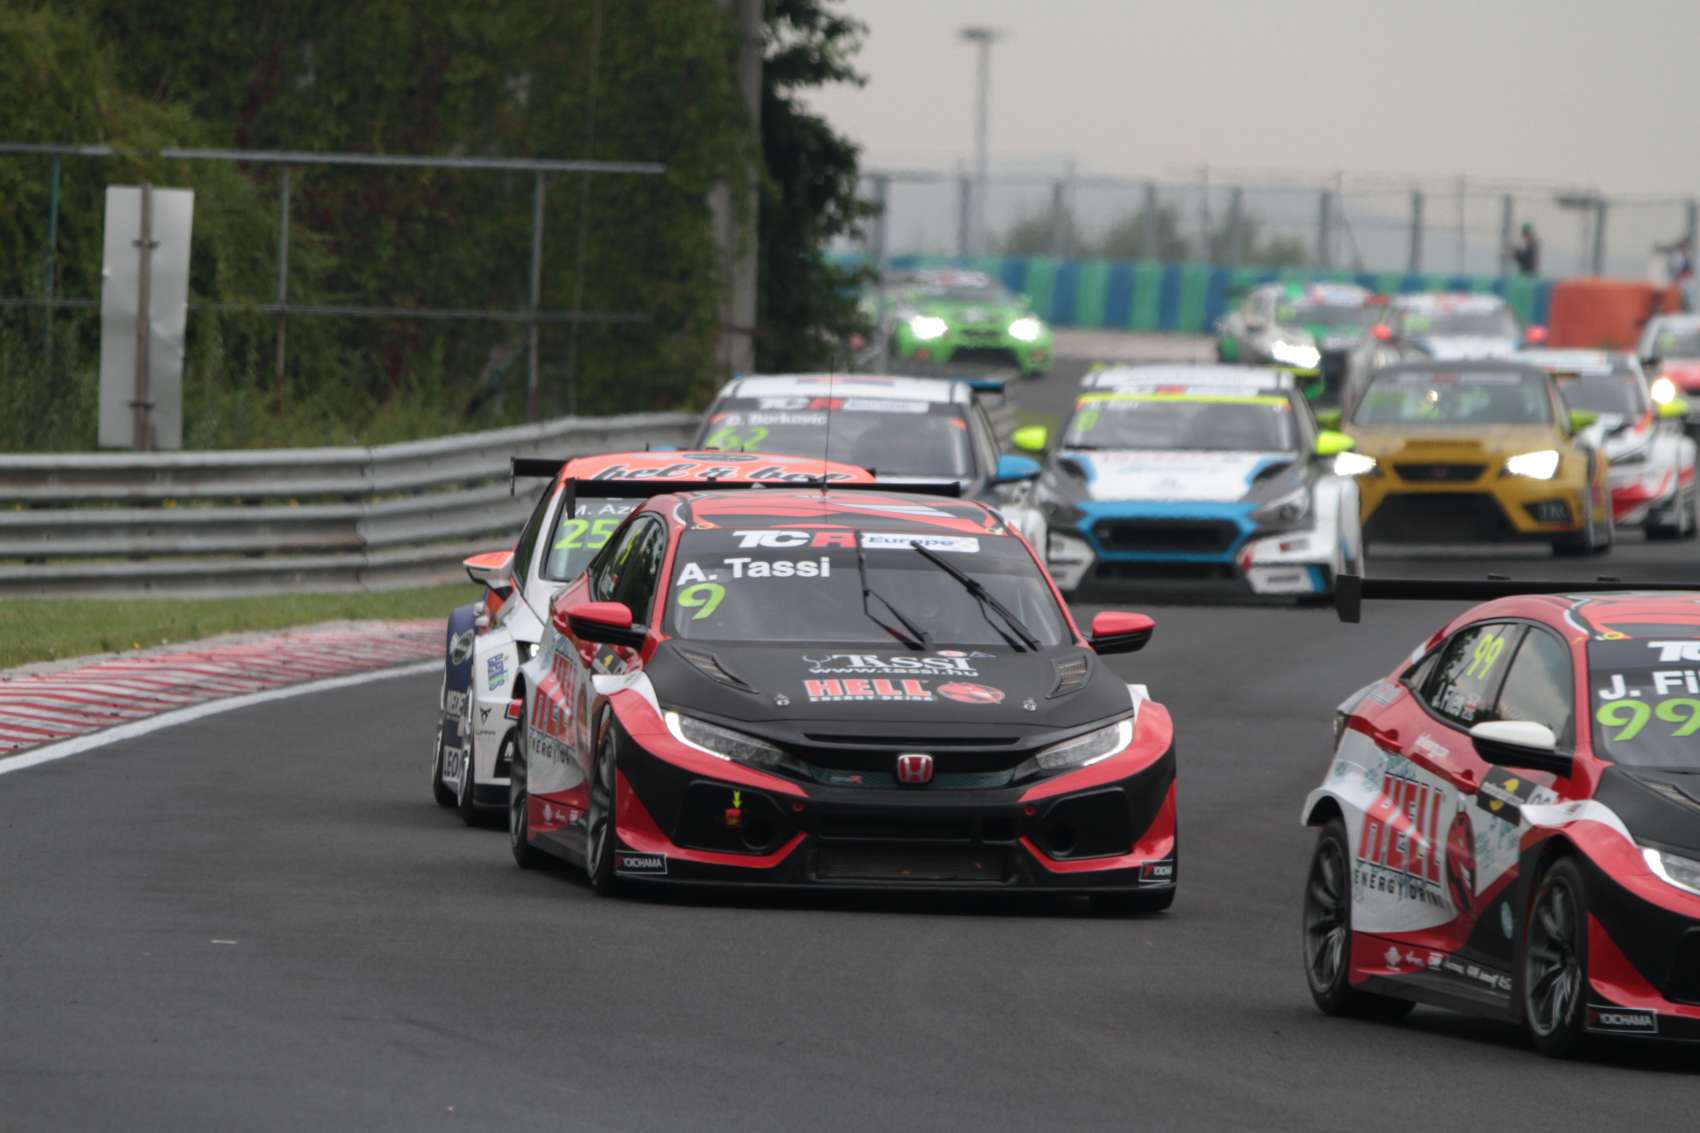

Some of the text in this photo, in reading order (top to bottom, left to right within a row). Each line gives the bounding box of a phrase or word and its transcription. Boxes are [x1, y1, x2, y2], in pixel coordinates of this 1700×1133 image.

[705, 426, 769, 450] 62
[554, 518, 620, 550] 25
[676, 557, 831, 586] A. Tassi
[677, 582, 727, 620] 9
[808, 666, 980, 677] www.tassi.hu
[1466, 632, 1505, 680] 99
[804, 679, 932, 697] HELL
[1597, 669, 1700, 700] J. Fi
[1596, 697, 1700, 741] 99
